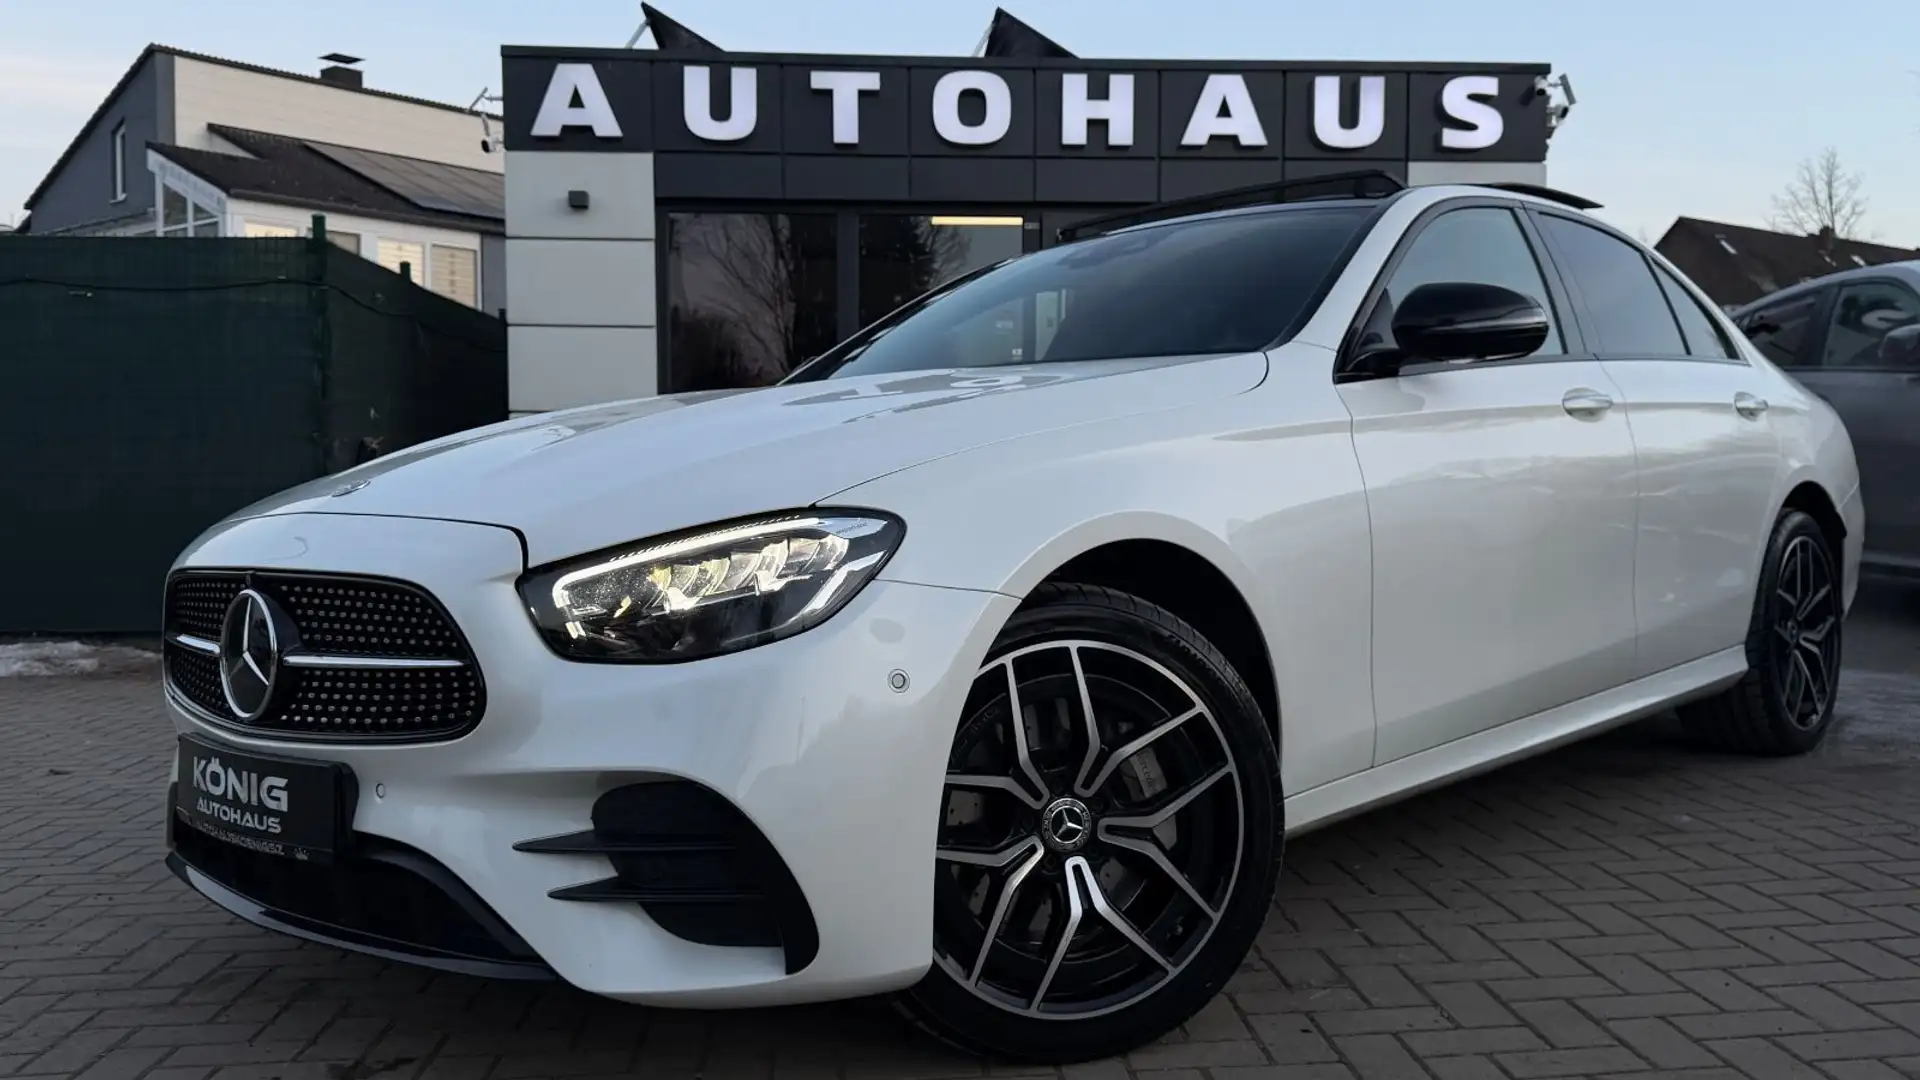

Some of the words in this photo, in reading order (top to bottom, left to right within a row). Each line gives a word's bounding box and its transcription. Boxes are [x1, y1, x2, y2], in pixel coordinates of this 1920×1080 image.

[531, 63, 1504, 149] AUTOHAUS
[193, 756, 288, 812] KÖNIG
[196, 797, 282, 834] AUTOHAUS
